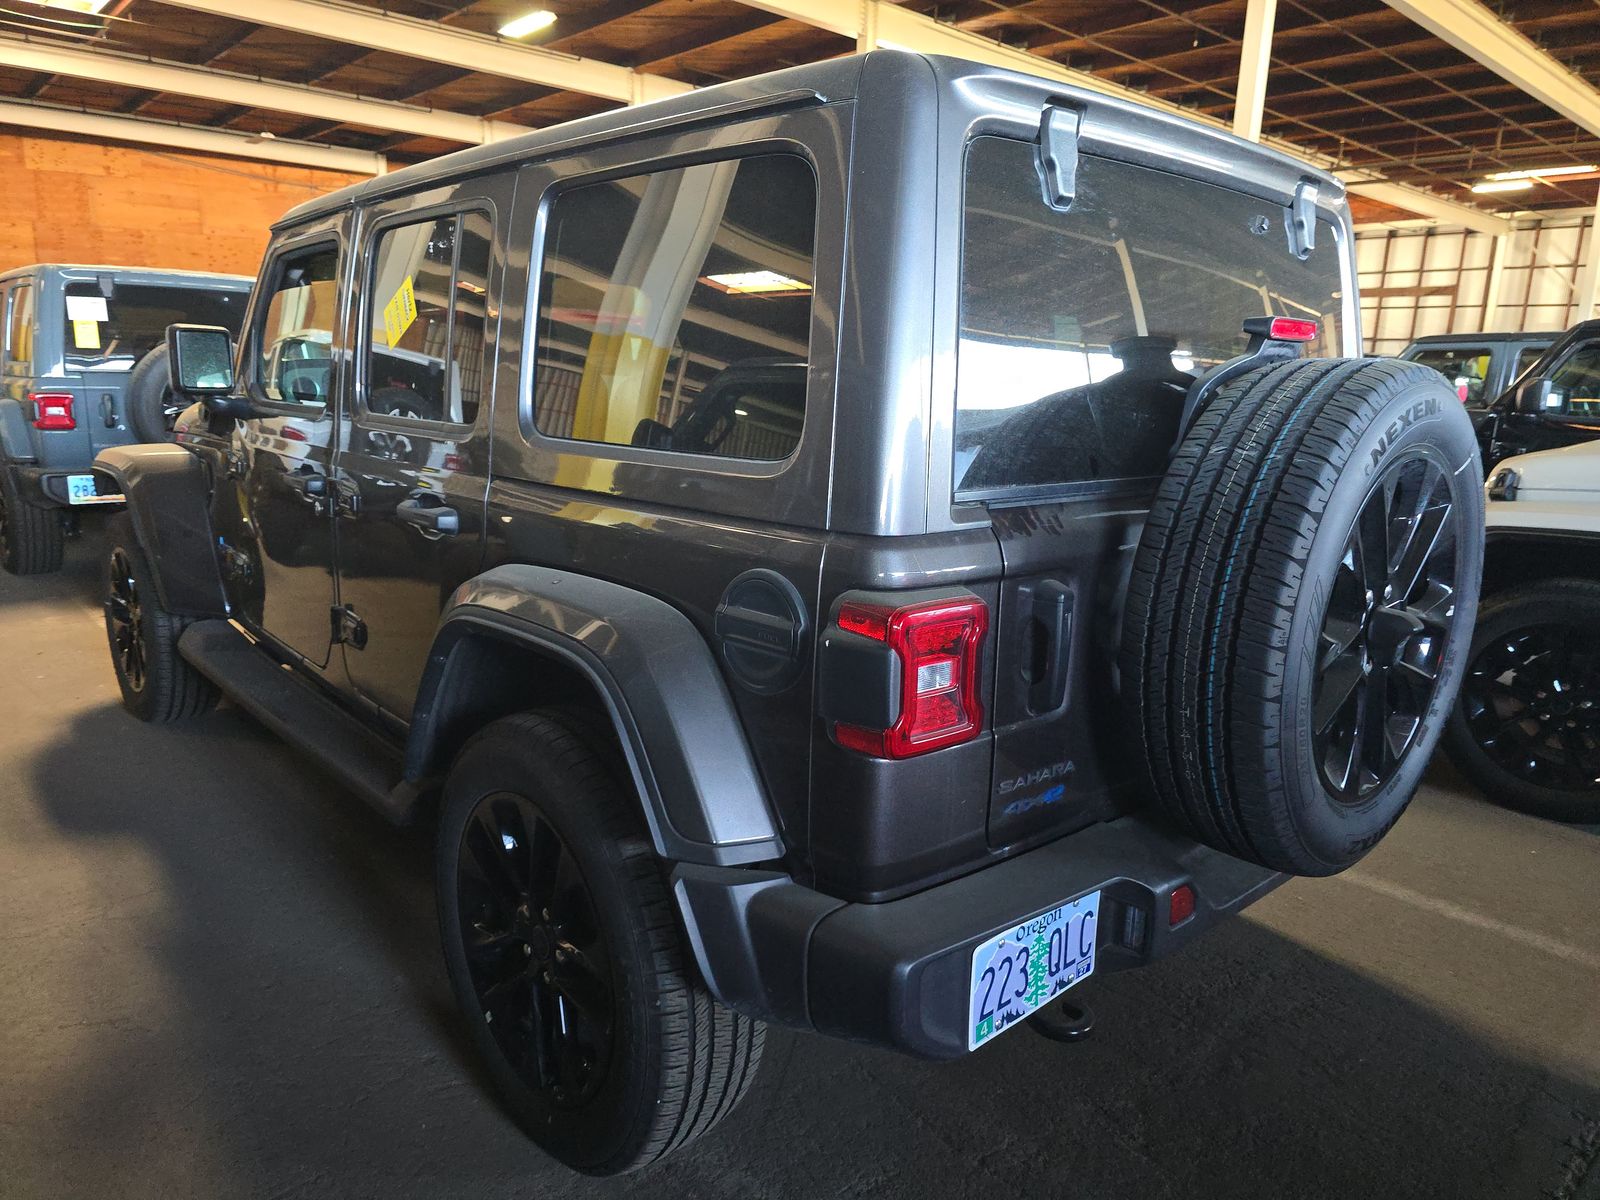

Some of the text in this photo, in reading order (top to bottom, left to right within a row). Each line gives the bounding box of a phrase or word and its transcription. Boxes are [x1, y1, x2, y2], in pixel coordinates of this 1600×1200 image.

[1370, 398, 1437, 467] NEXEN
[999, 760, 1075, 795] SAHARA
[1016, 908, 1062, 942] Oregon
[979, 910, 1094, 1022] 223 QLC
[980, 1021, 989, 1037] 4
